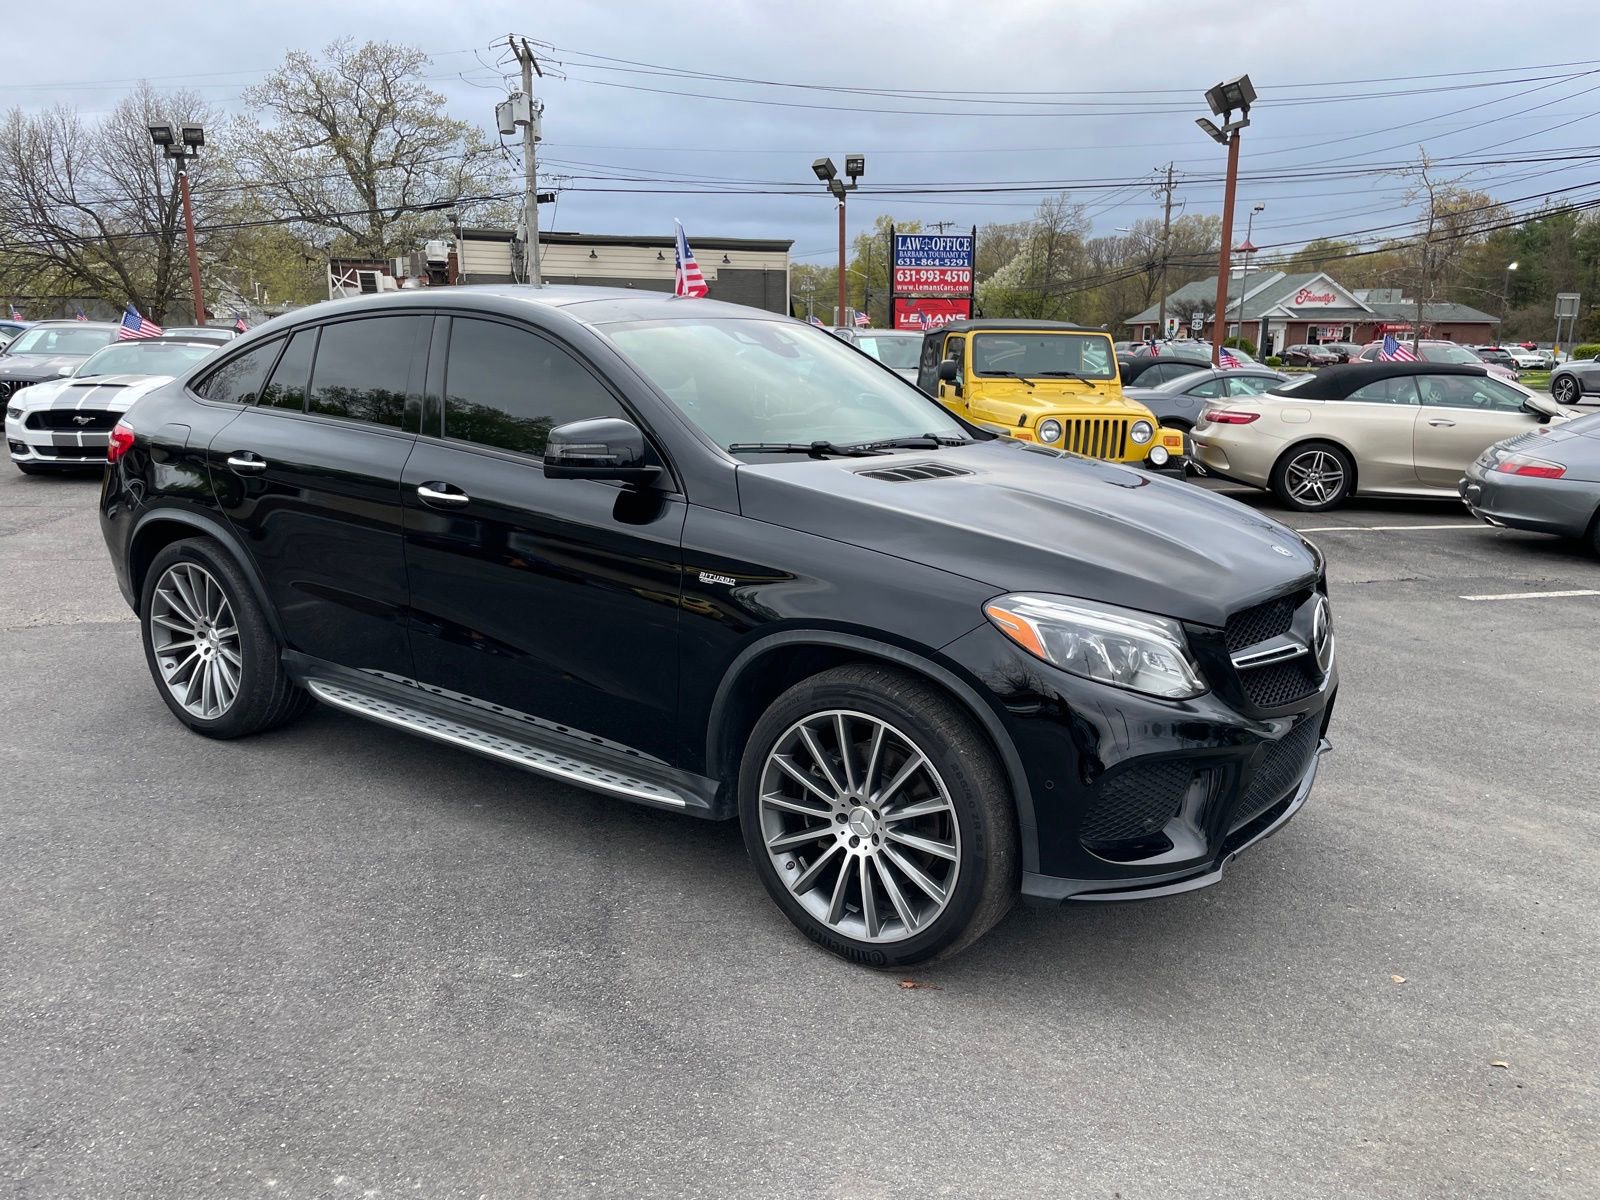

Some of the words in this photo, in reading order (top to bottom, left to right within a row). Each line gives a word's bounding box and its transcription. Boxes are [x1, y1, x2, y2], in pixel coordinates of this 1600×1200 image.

[898, 237, 922, 250] LAW
[931, 237, 970, 251] OFFICE
[899, 250, 928, 258] BARBARA
[897, 258, 969, 266] 631-864-5291
[897, 270, 970, 283] 631-993-4510
[896, 283, 969, 291] www.LemansCars.com
[1295, 288, 1337, 305] Friendly's
